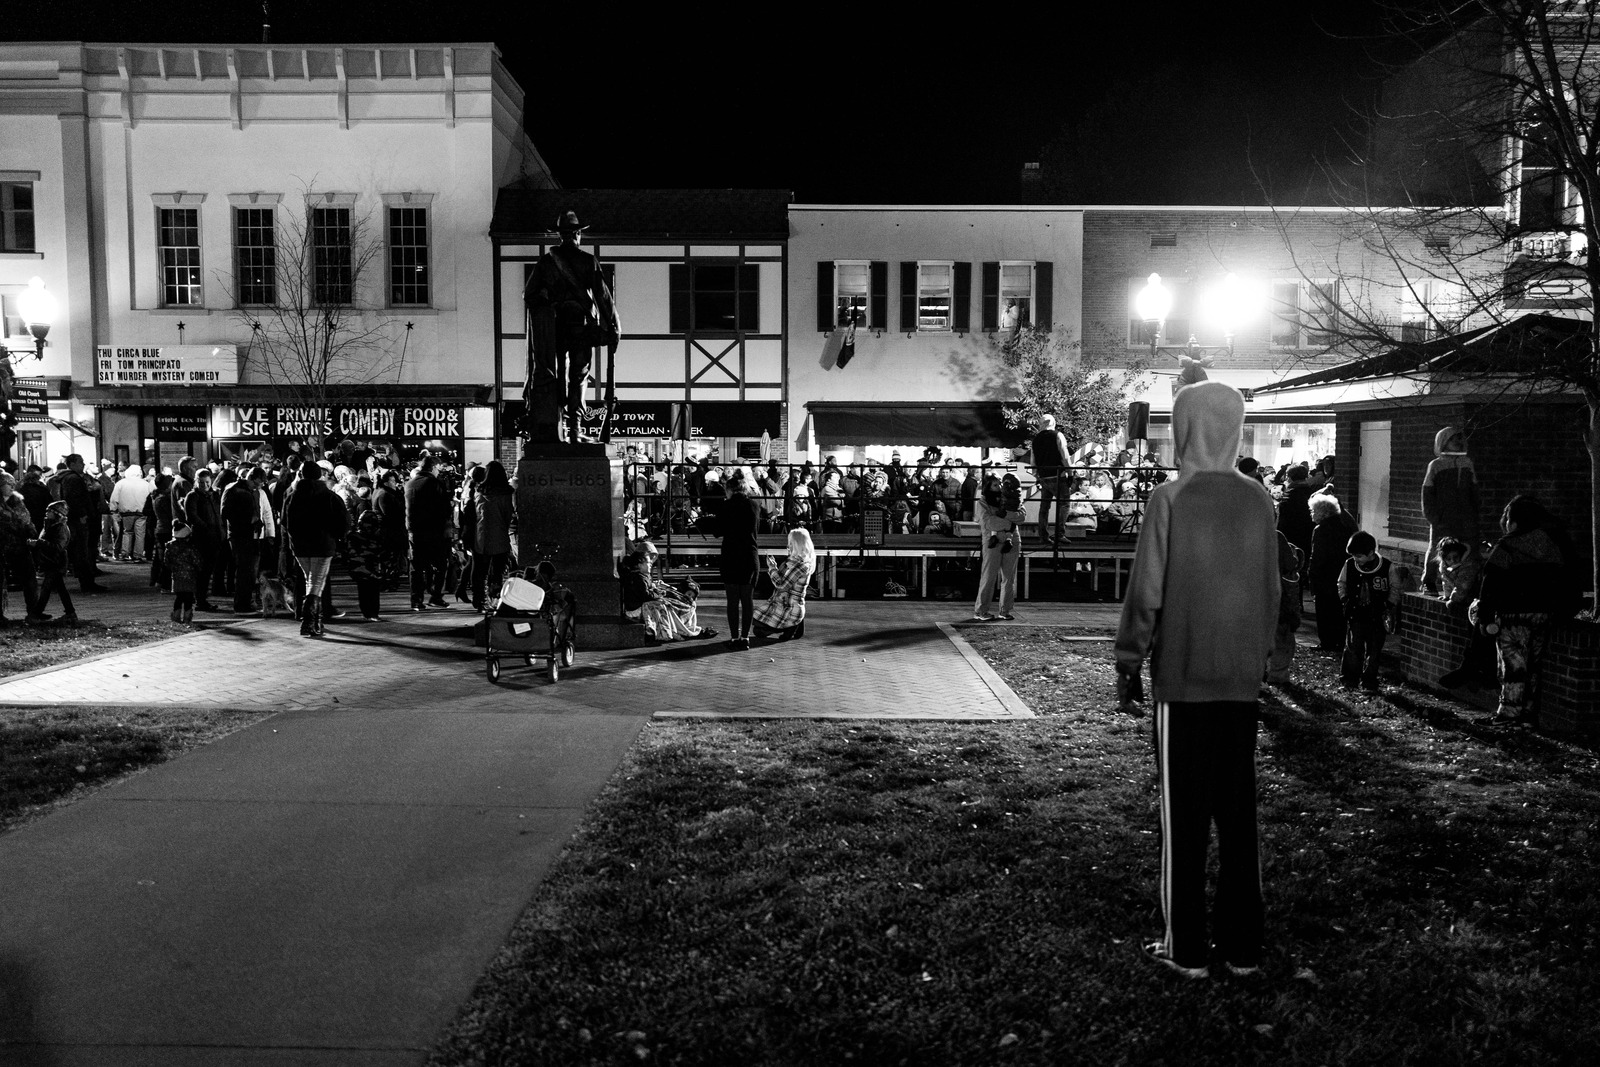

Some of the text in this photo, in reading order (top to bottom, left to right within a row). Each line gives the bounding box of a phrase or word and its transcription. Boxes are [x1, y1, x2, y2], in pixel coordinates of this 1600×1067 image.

[98, 348, 160, 357] THU CIRCA BLUE
[101, 360, 181, 369] FRI TOM PRINCIPATO
[99, 371, 220, 381] SAT MURDER MYSTERY COMEDY
[214, 408, 269, 421] LIVE
[277, 408, 332, 421] PRIVATE
[622, 413, 656, 421] TOWN
[340, 408, 395, 435] COMEDY
[214, 422, 269, 435] USIC
[403, 423, 460, 436] DRINK
[627, 427, 665, 435] ITALIAN
[1373, 576, 1388, 591] 91
